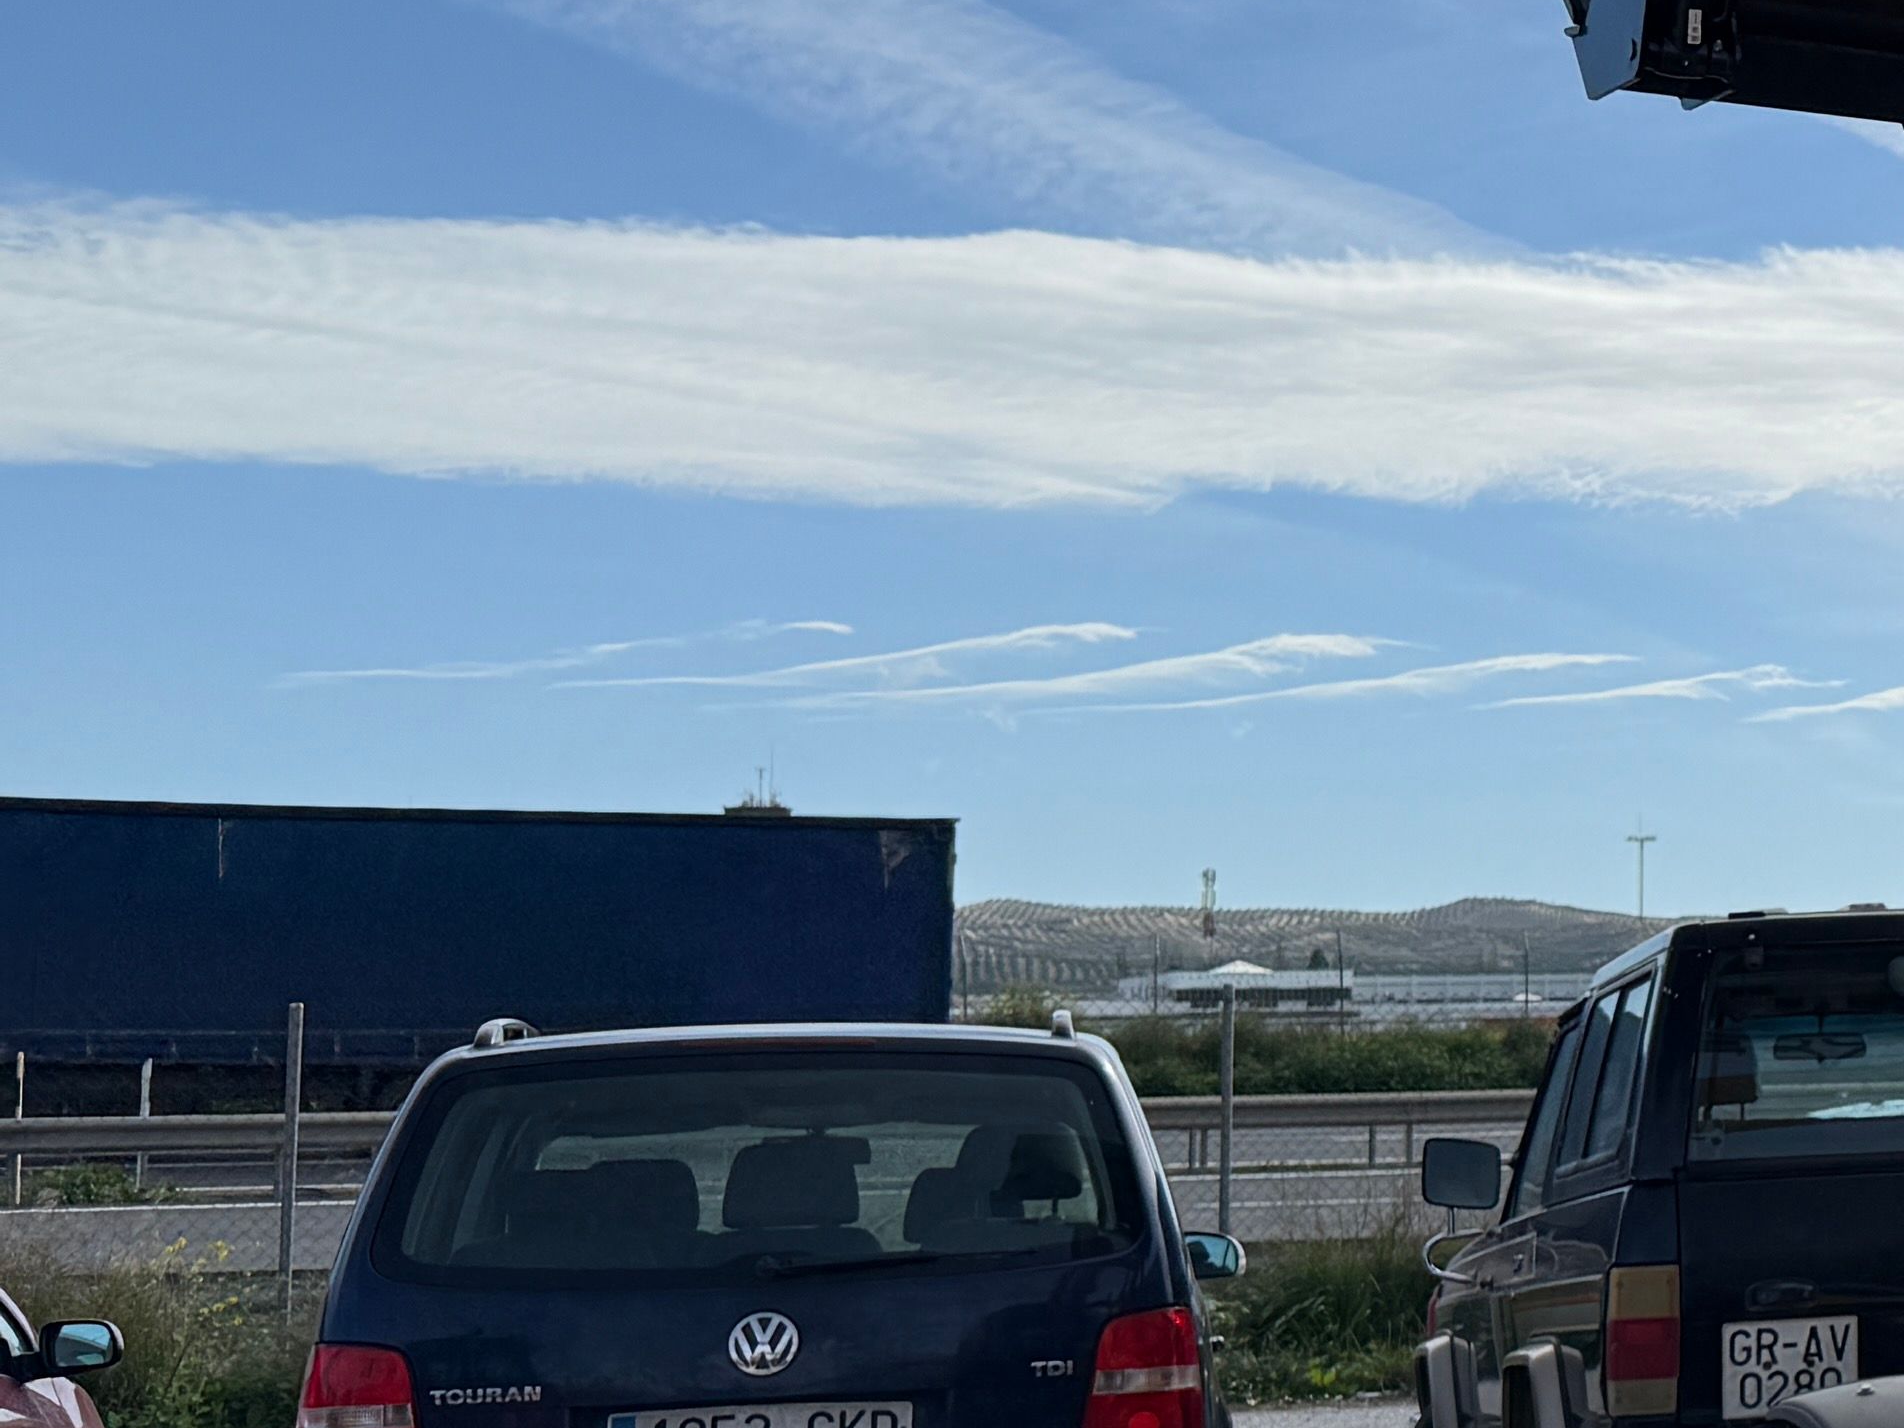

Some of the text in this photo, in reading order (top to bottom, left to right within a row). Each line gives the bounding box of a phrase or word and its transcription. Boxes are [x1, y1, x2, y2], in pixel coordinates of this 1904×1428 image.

[1729, 1323, 1851, 1366] GR-AV
[1030, 1360, 1074, 1378] TDI
[430, 1385, 543, 1407] TOURAN
